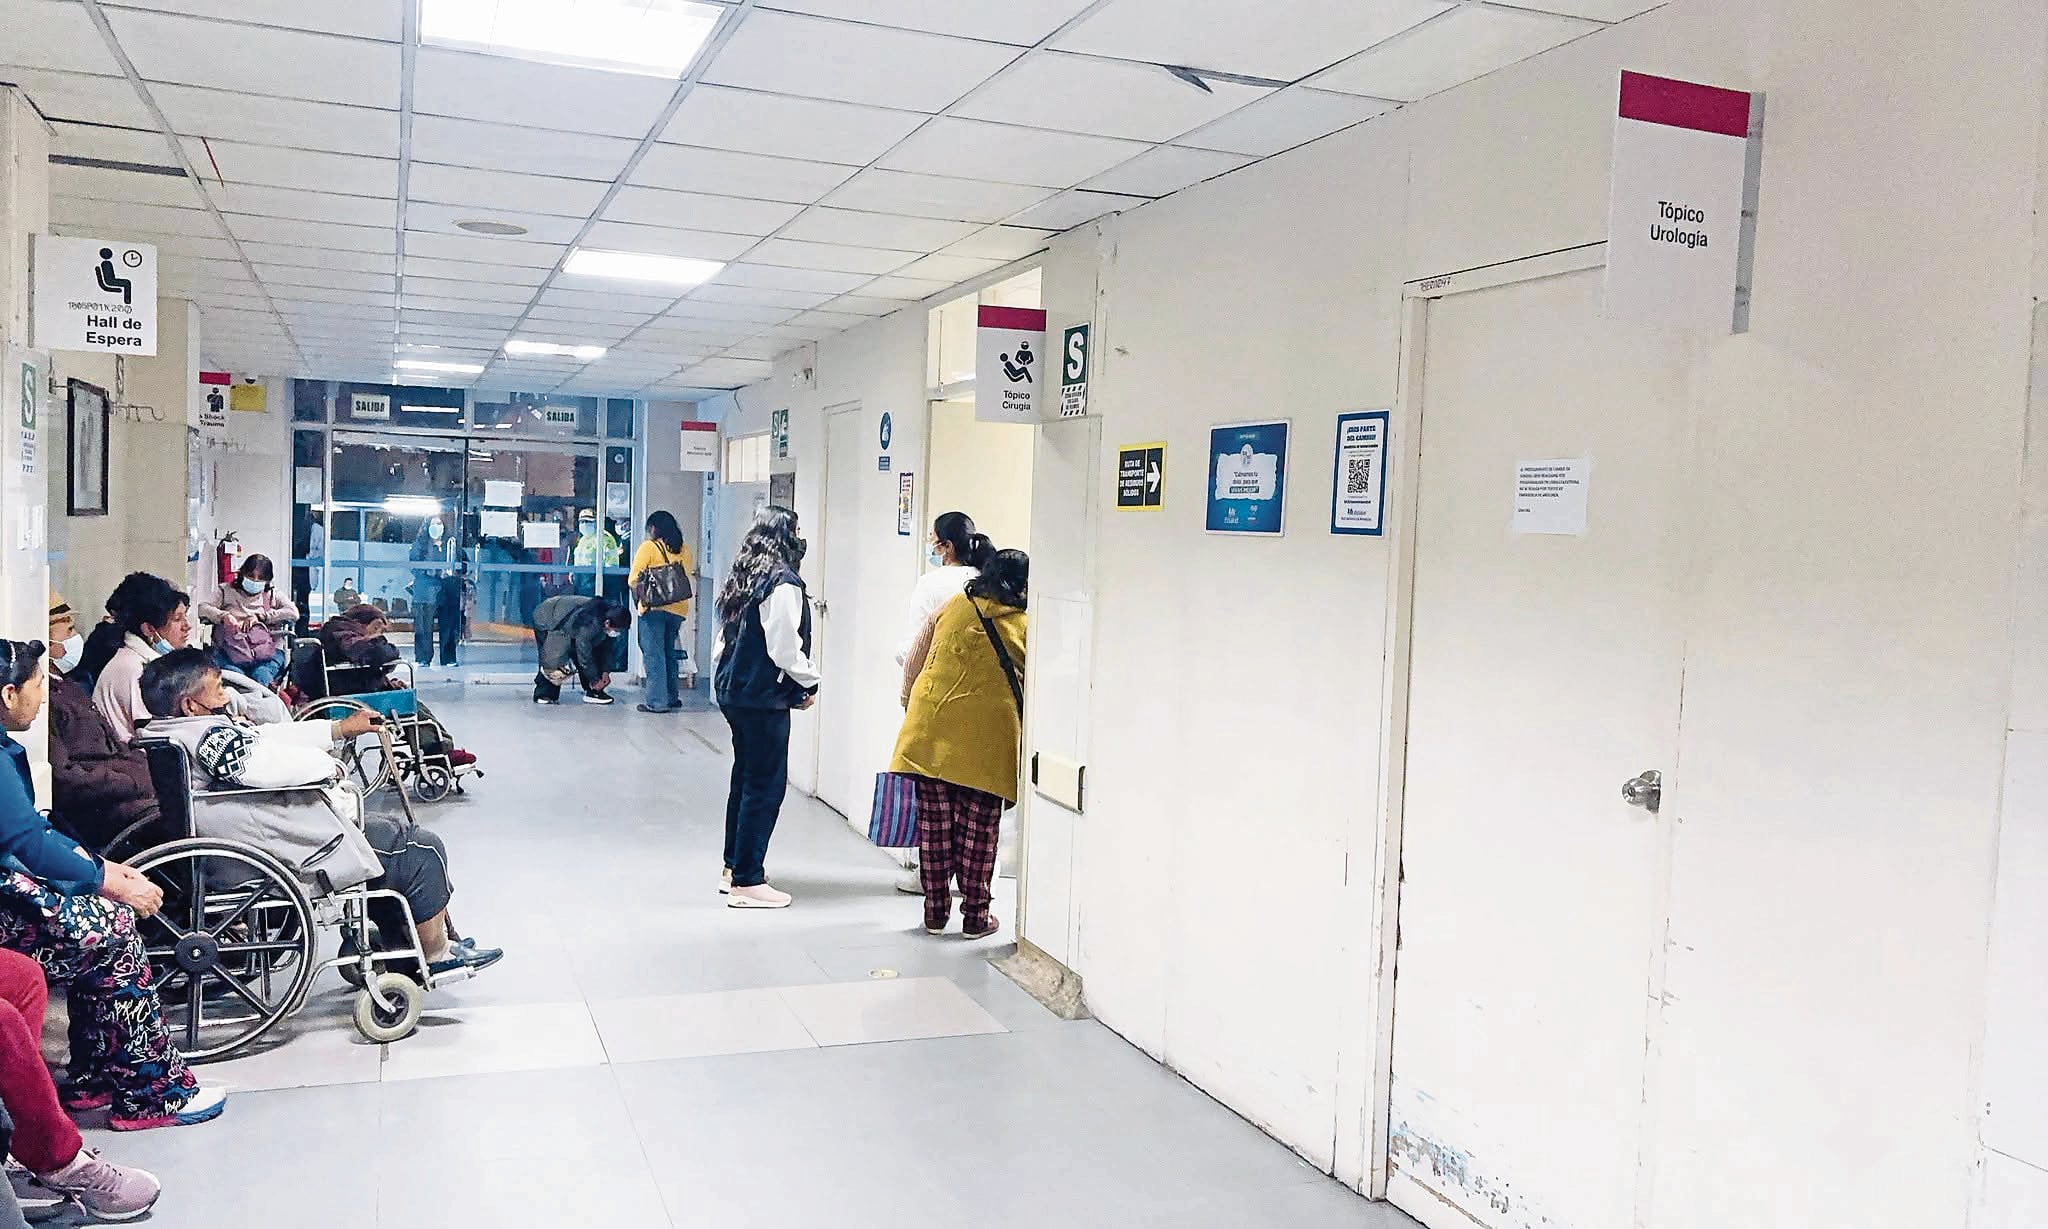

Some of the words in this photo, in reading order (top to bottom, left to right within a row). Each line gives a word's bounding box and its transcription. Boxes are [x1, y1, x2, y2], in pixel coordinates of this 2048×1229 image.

[1658, 201, 1704, 223] Tópico
[1650, 224, 1708, 249] Urología
[87, 315, 117, 328] Hall
[122, 318, 142, 330] de
[86, 331, 142, 347] Espera
[1067, 332, 1084, 380] S
[1003, 390, 1031, 400] Tópico
[355, 400, 385, 413] SALIDA
[1002, 401, 1031, 412] Cirugía
[546, 409, 575, 423] SALIDA
